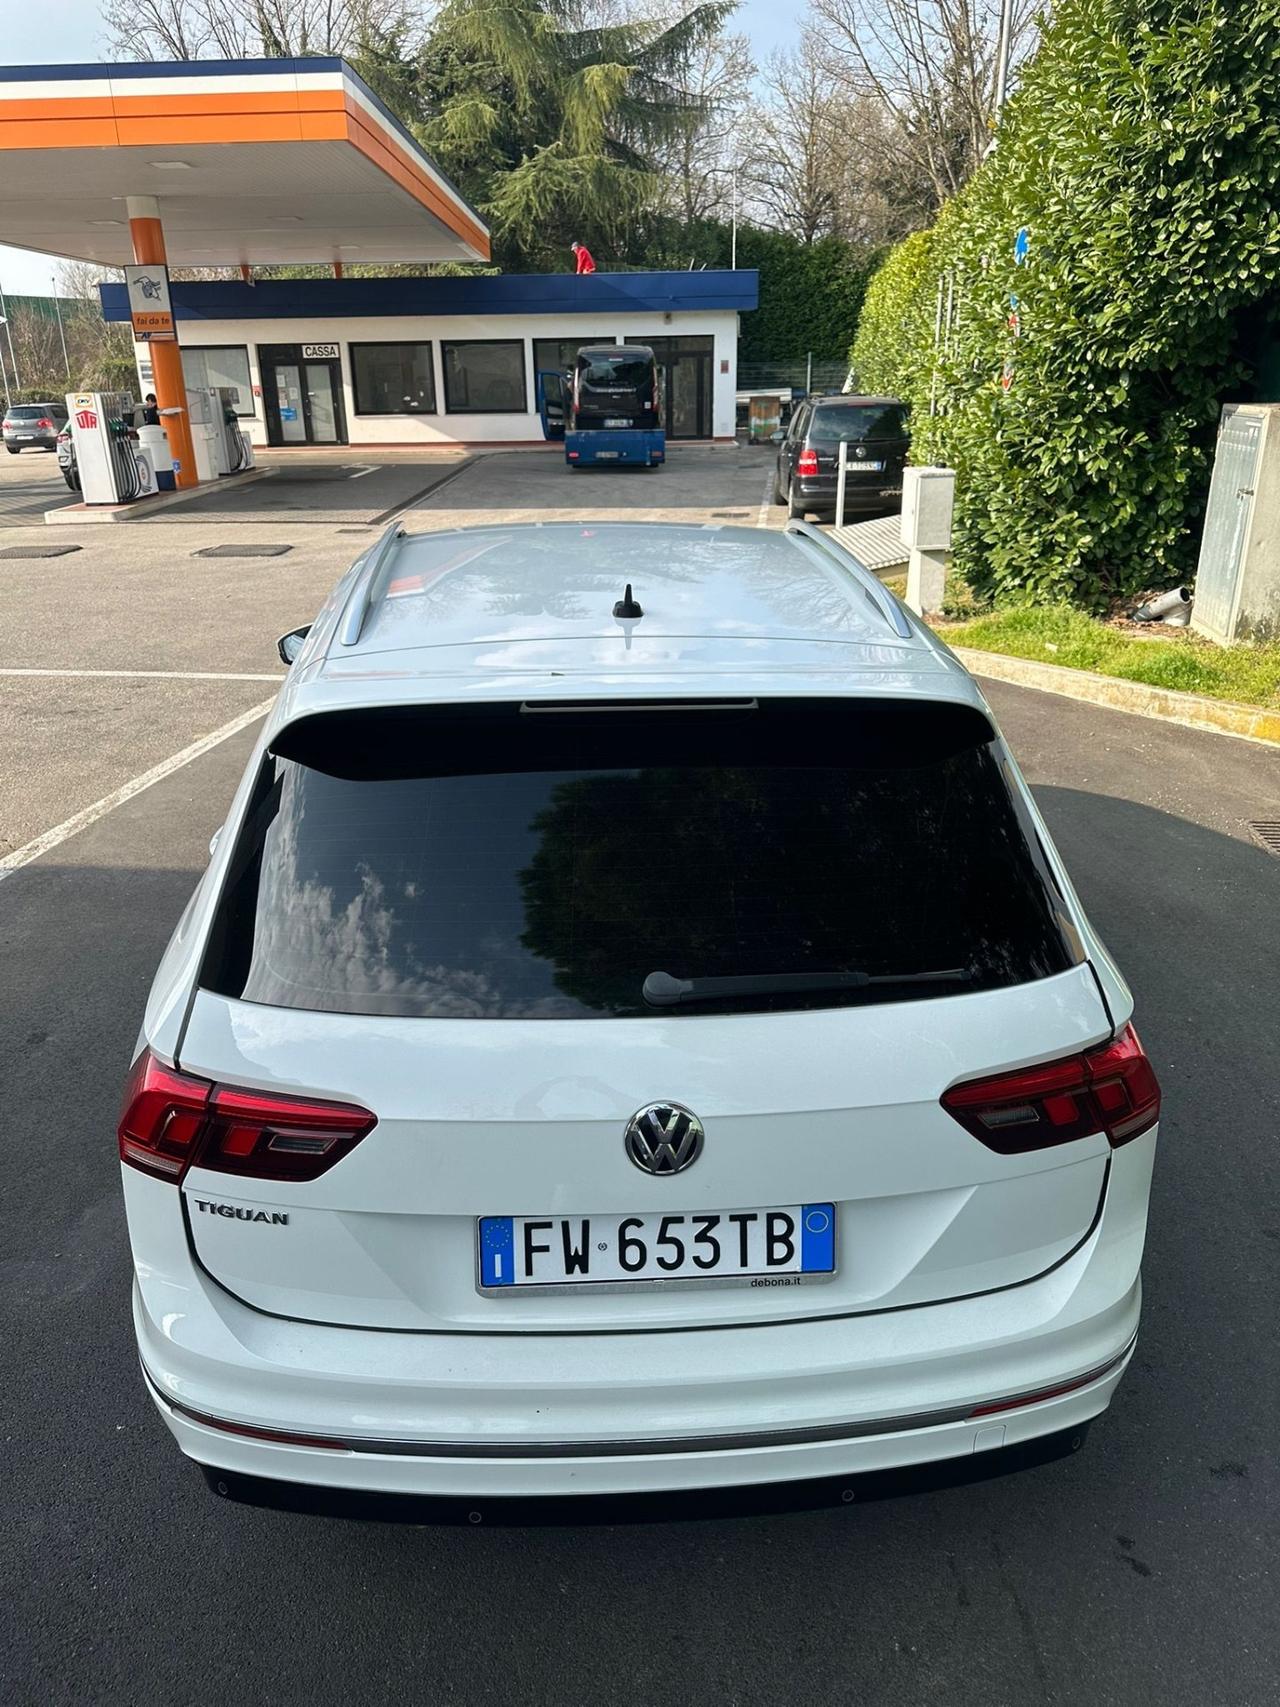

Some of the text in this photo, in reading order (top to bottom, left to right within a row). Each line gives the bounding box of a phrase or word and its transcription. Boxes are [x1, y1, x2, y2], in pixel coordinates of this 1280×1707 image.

[137, 316, 148, 325] fai
[149, 316, 159, 325] da
[304, 345, 337, 357] CASSA
[75, 410, 97, 429] UTA
[194, 1197, 289, 1226] TIGUAN
[523, 1218, 591, 1277] FW
[617, 1211, 796, 1273] 653TB
[750, 1276, 801, 1288] debona.it
